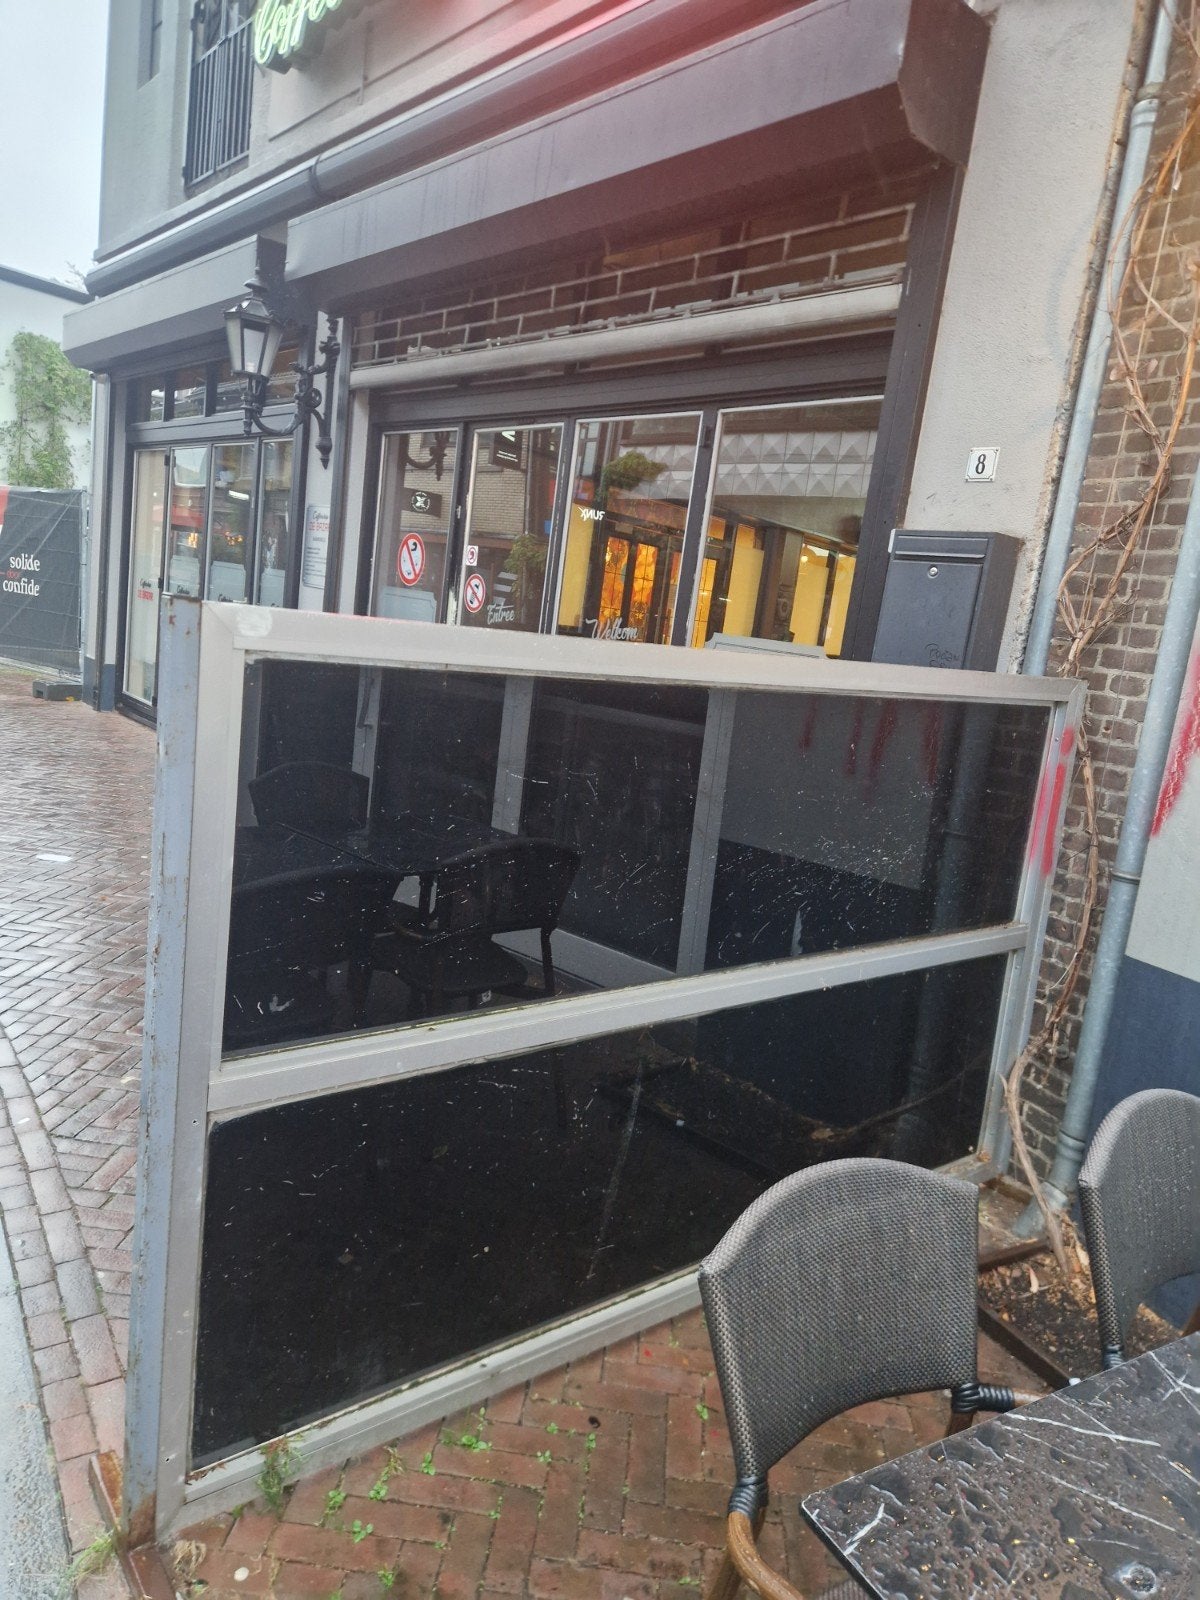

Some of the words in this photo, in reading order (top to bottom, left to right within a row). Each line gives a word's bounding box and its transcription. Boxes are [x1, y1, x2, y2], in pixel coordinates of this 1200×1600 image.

[975, 453, 986, 475] 8
[9, 553, 40, 571] solide
[2, 578, 40, 596] confide
[585, 617, 638, 641] Welkom
